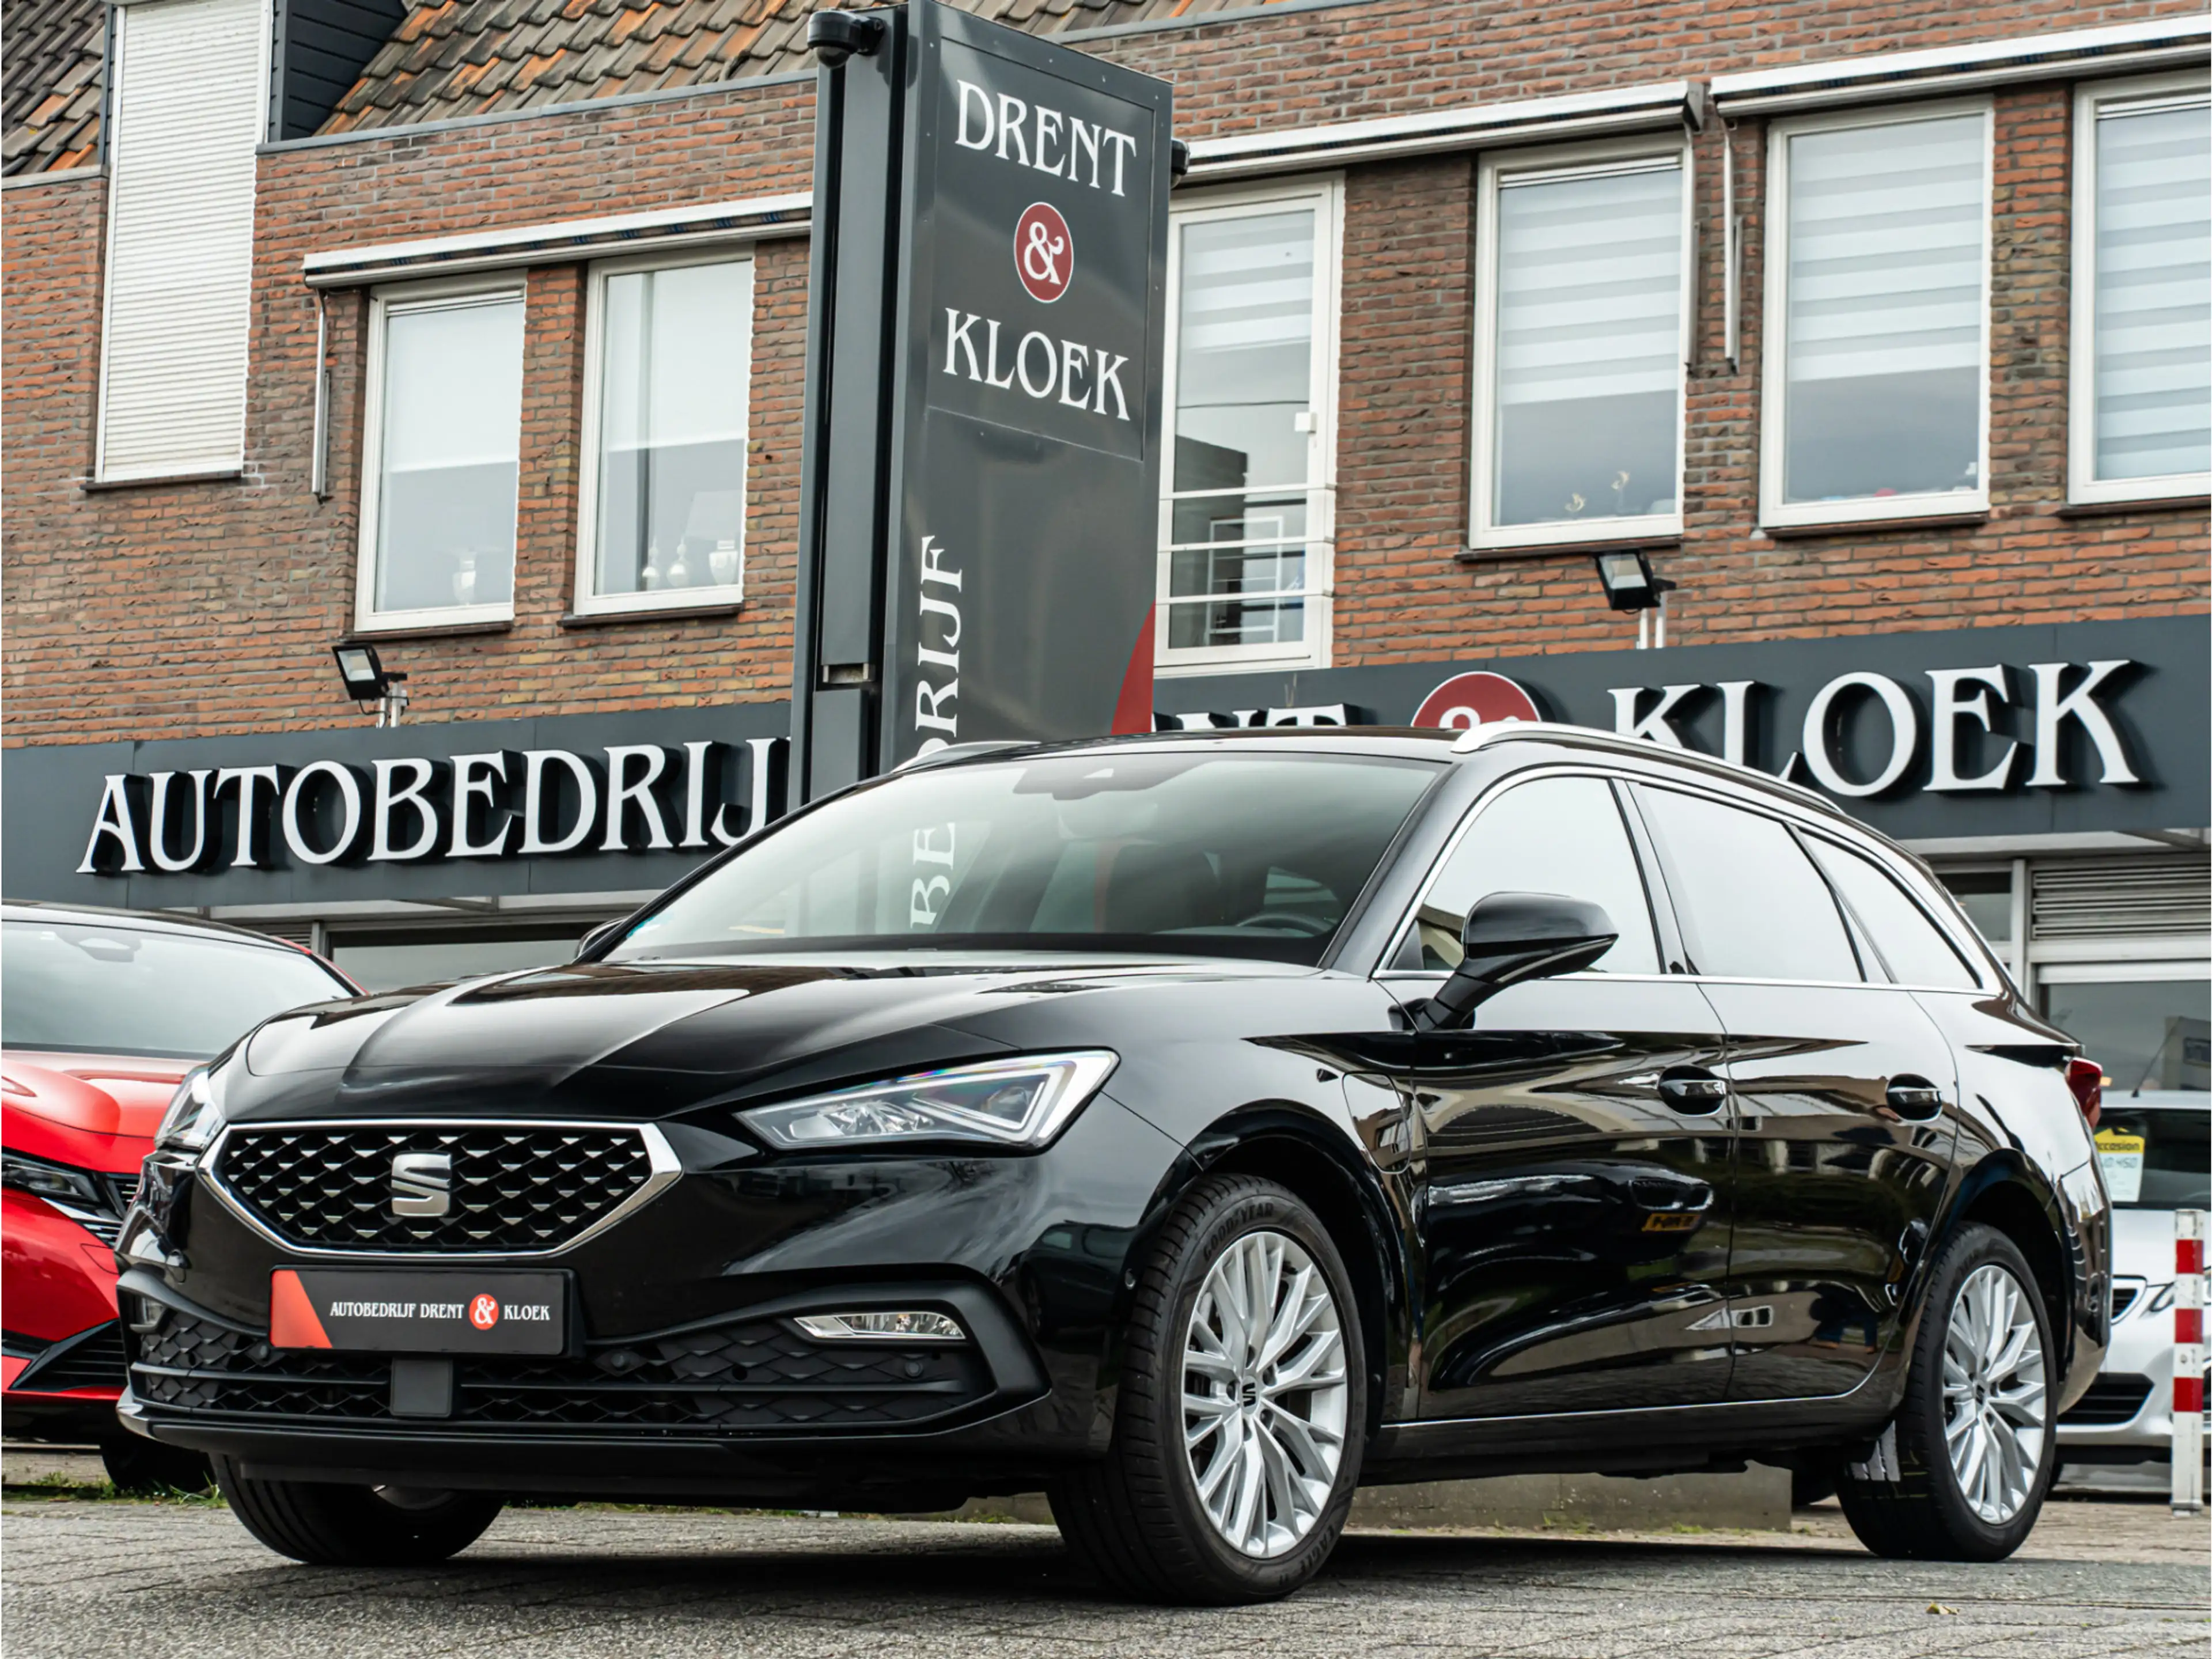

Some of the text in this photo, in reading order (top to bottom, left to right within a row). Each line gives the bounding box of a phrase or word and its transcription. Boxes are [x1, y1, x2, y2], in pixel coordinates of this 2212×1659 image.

[955, 79, 1137, 196] DRENT
[1023, 221, 1065, 285] &
[942, 307, 1131, 421] KLOEK
[76, 737, 791, 874] AUTOBEDRIJ
[329, 1297, 551, 1325] AUTOBEDRIJF DRENT & KLOEK
